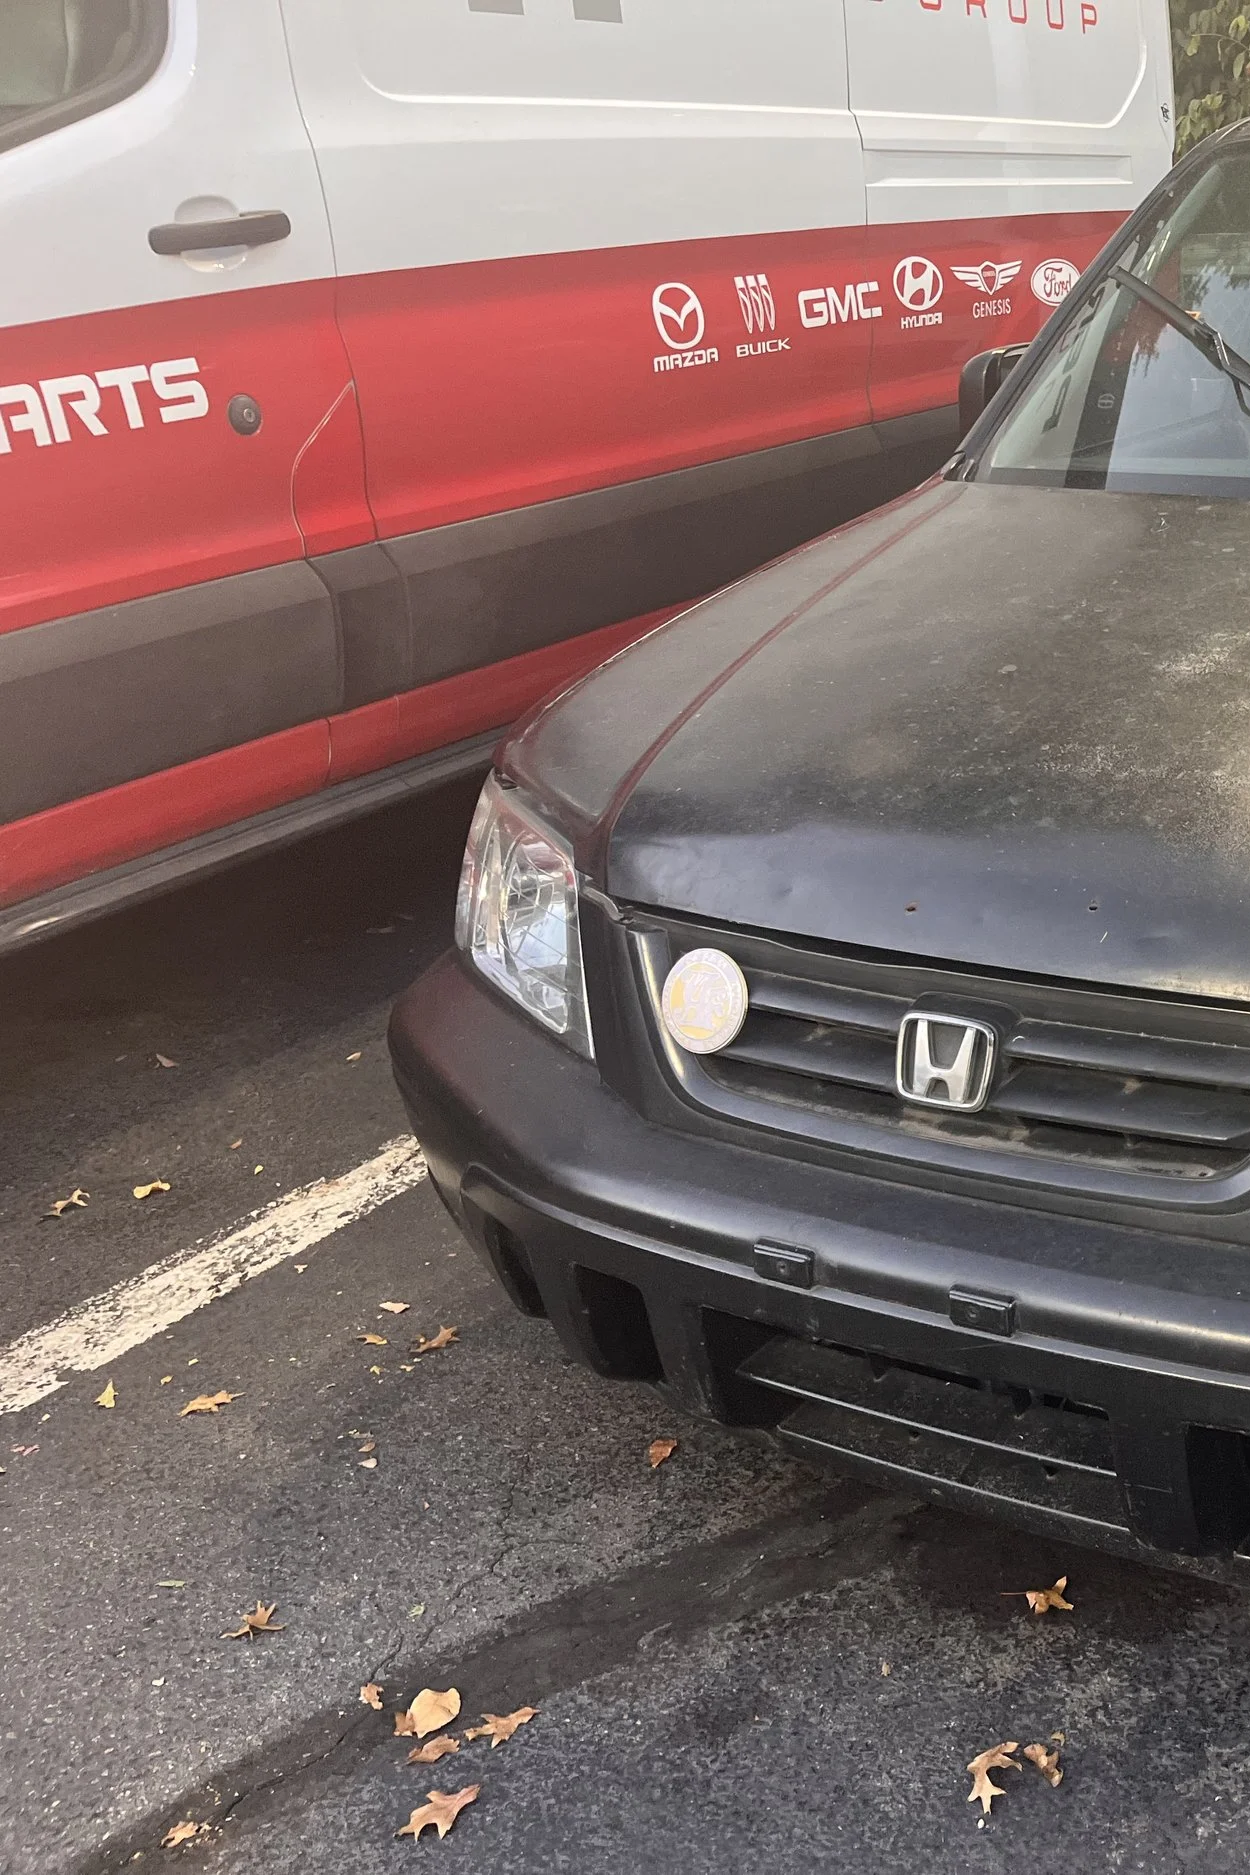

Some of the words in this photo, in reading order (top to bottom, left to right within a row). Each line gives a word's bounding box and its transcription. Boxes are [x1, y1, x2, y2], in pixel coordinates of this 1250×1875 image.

[1043, 267, 1072, 298] Ford
[798, 281, 883, 329] GMC
[972, 298, 1012, 318] GENESIS
[900, 312, 943, 329] HYUNDAI
[735, 337, 791, 358] BUICK
[653, 347, 719, 373] MAZDA
